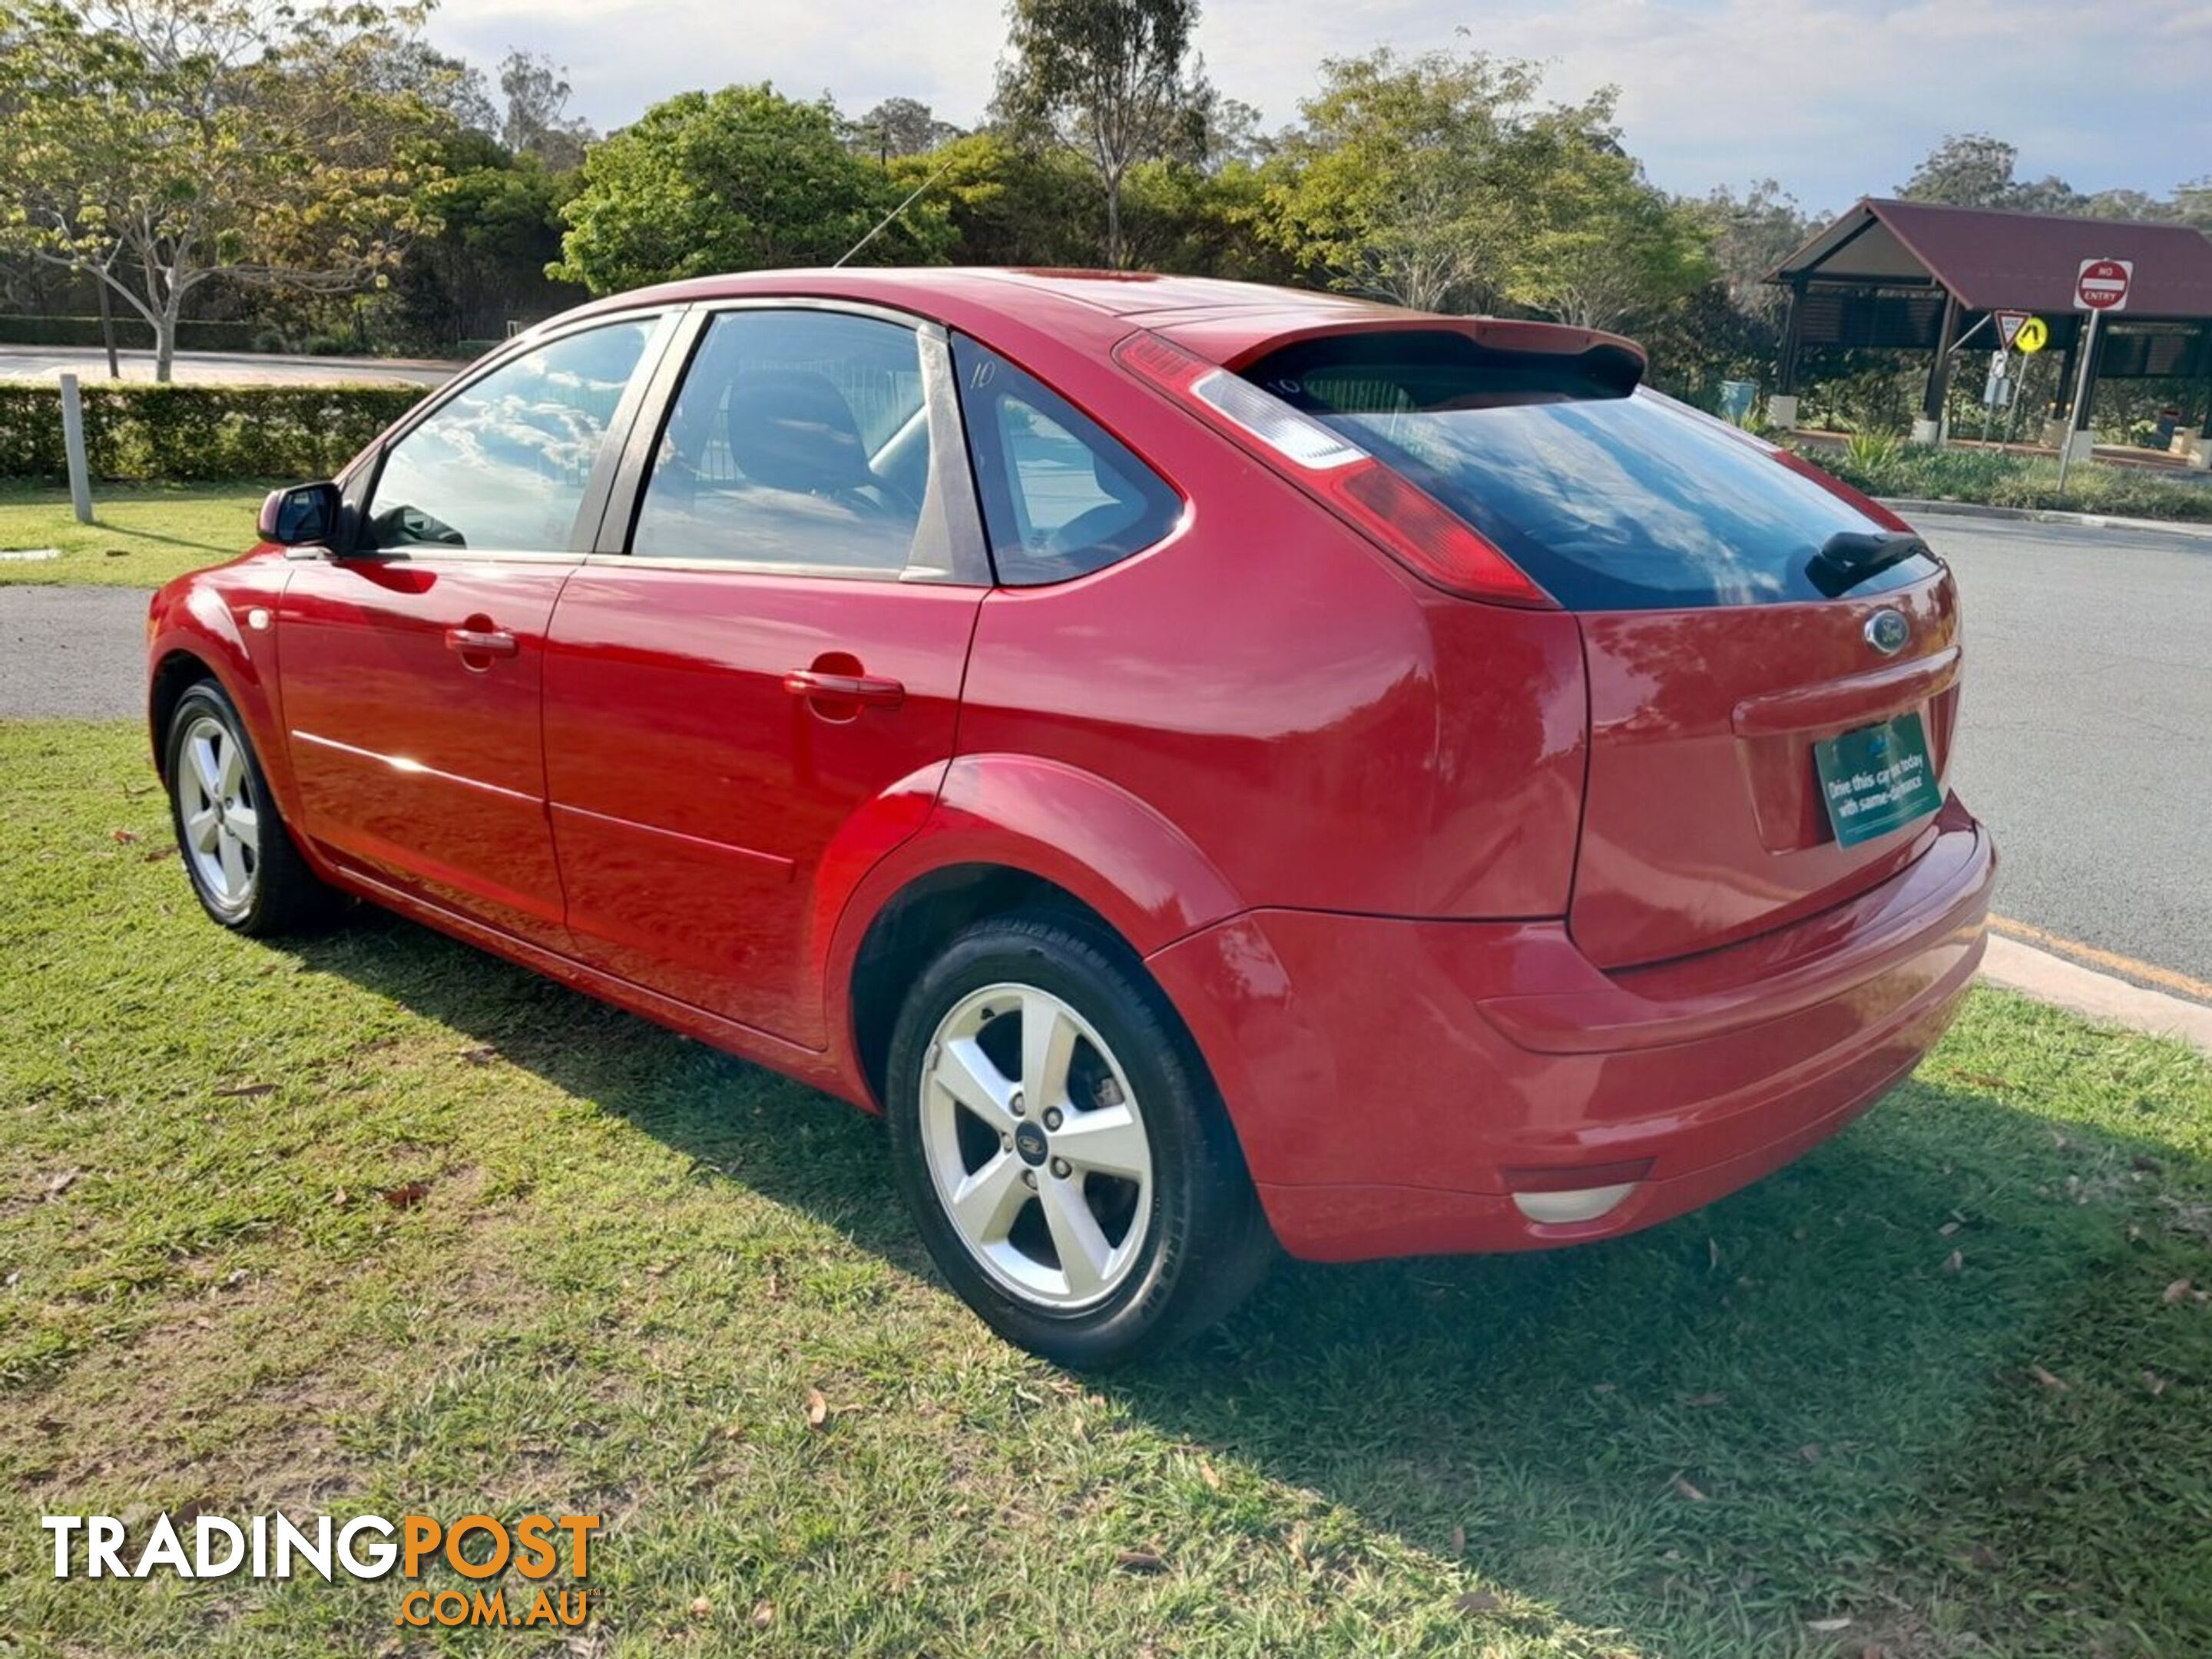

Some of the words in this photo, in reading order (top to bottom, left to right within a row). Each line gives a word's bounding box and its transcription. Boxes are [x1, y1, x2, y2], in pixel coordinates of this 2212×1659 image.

[2098, 267, 2114, 276] NO
[2084, 291, 2118, 301] ENTRY
[969, 360, 996, 389] 10
[1827, 778, 1853, 800] Drive
[1852, 771, 1876, 792] this
[1839, 798, 1859, 818] with
